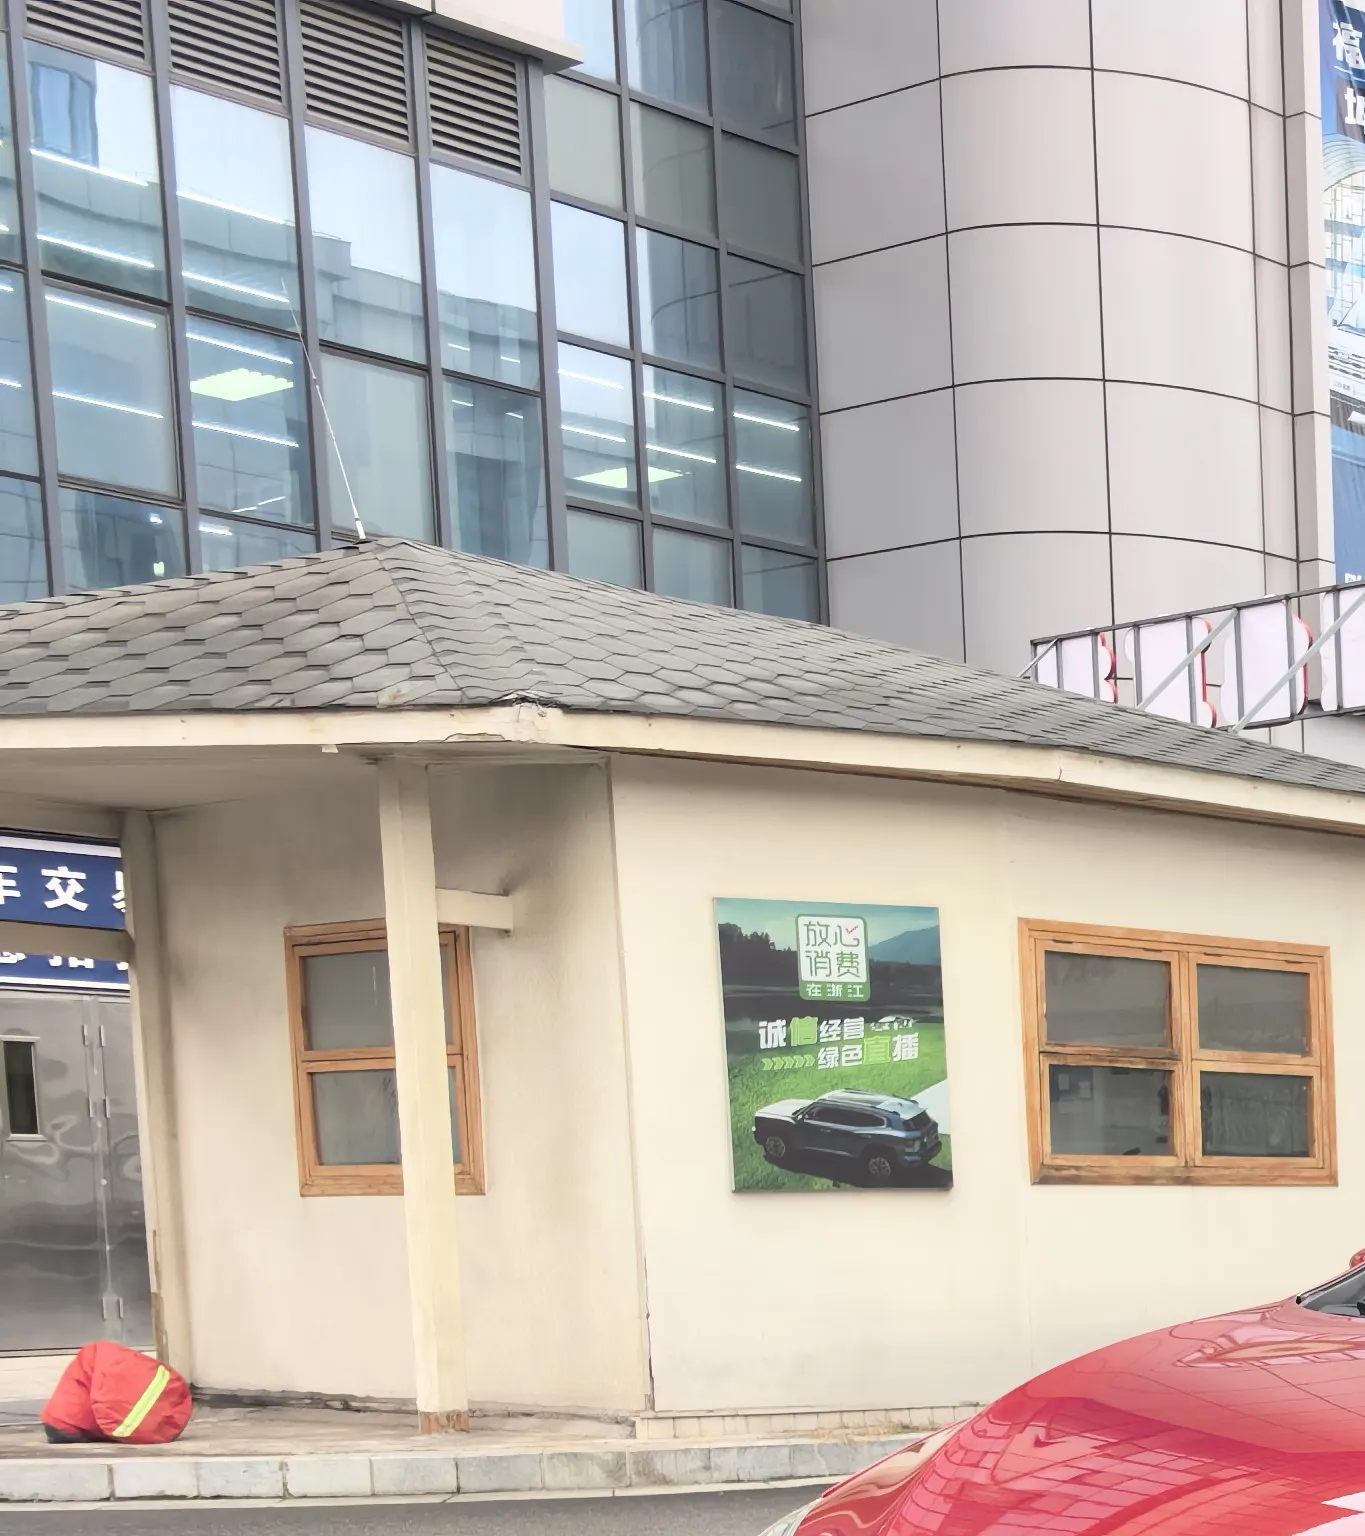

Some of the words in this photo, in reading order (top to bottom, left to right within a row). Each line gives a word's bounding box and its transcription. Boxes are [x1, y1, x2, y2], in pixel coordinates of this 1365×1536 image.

[803, 920, 860, 948] 放心
[805, 950, 861, 978] 消费
[806, 983, 864, 998] 在浙江
[758, 1016, 865, 1049] 诚信经营
[817, 1032, 919, 1070] 绿色直播
